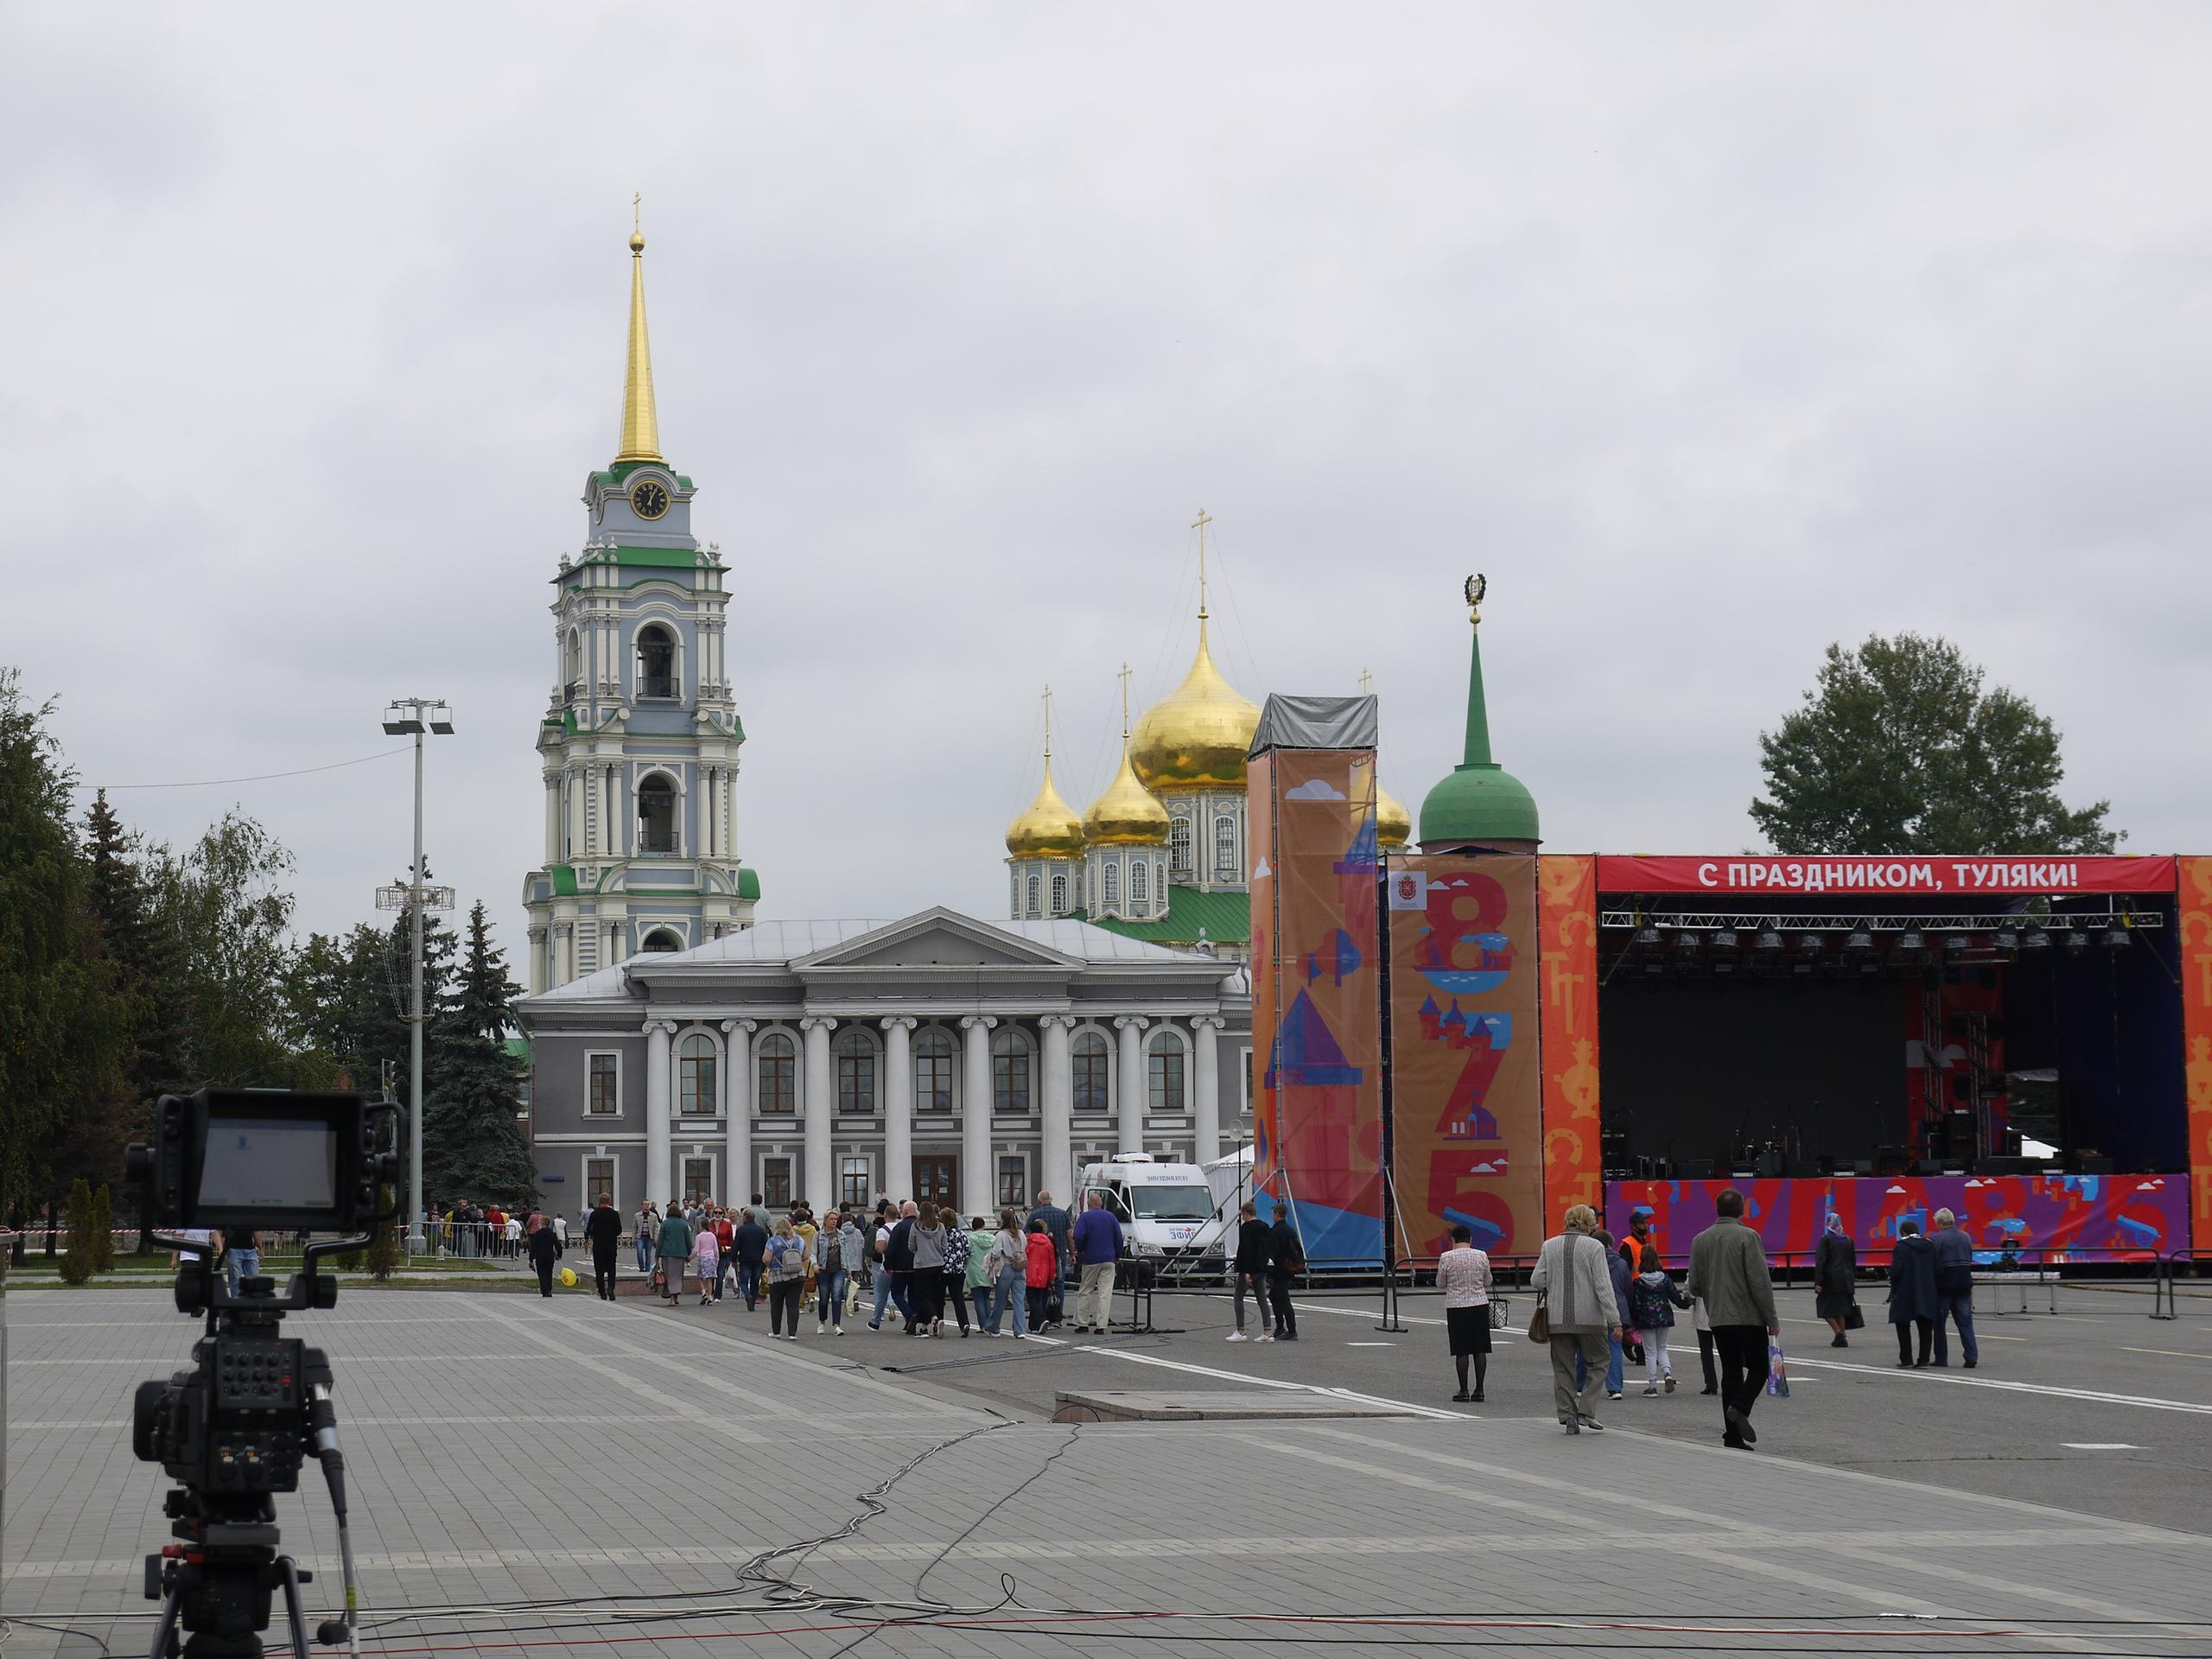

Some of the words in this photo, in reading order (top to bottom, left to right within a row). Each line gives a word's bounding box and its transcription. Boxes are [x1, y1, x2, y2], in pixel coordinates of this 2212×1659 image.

[1698, 863, 1719, 887] С
[1728, 863, 1944, 892] ПРАЗДНИКОМ,
[1952, 863, 2078, 888] ТУЛЯКИ!
